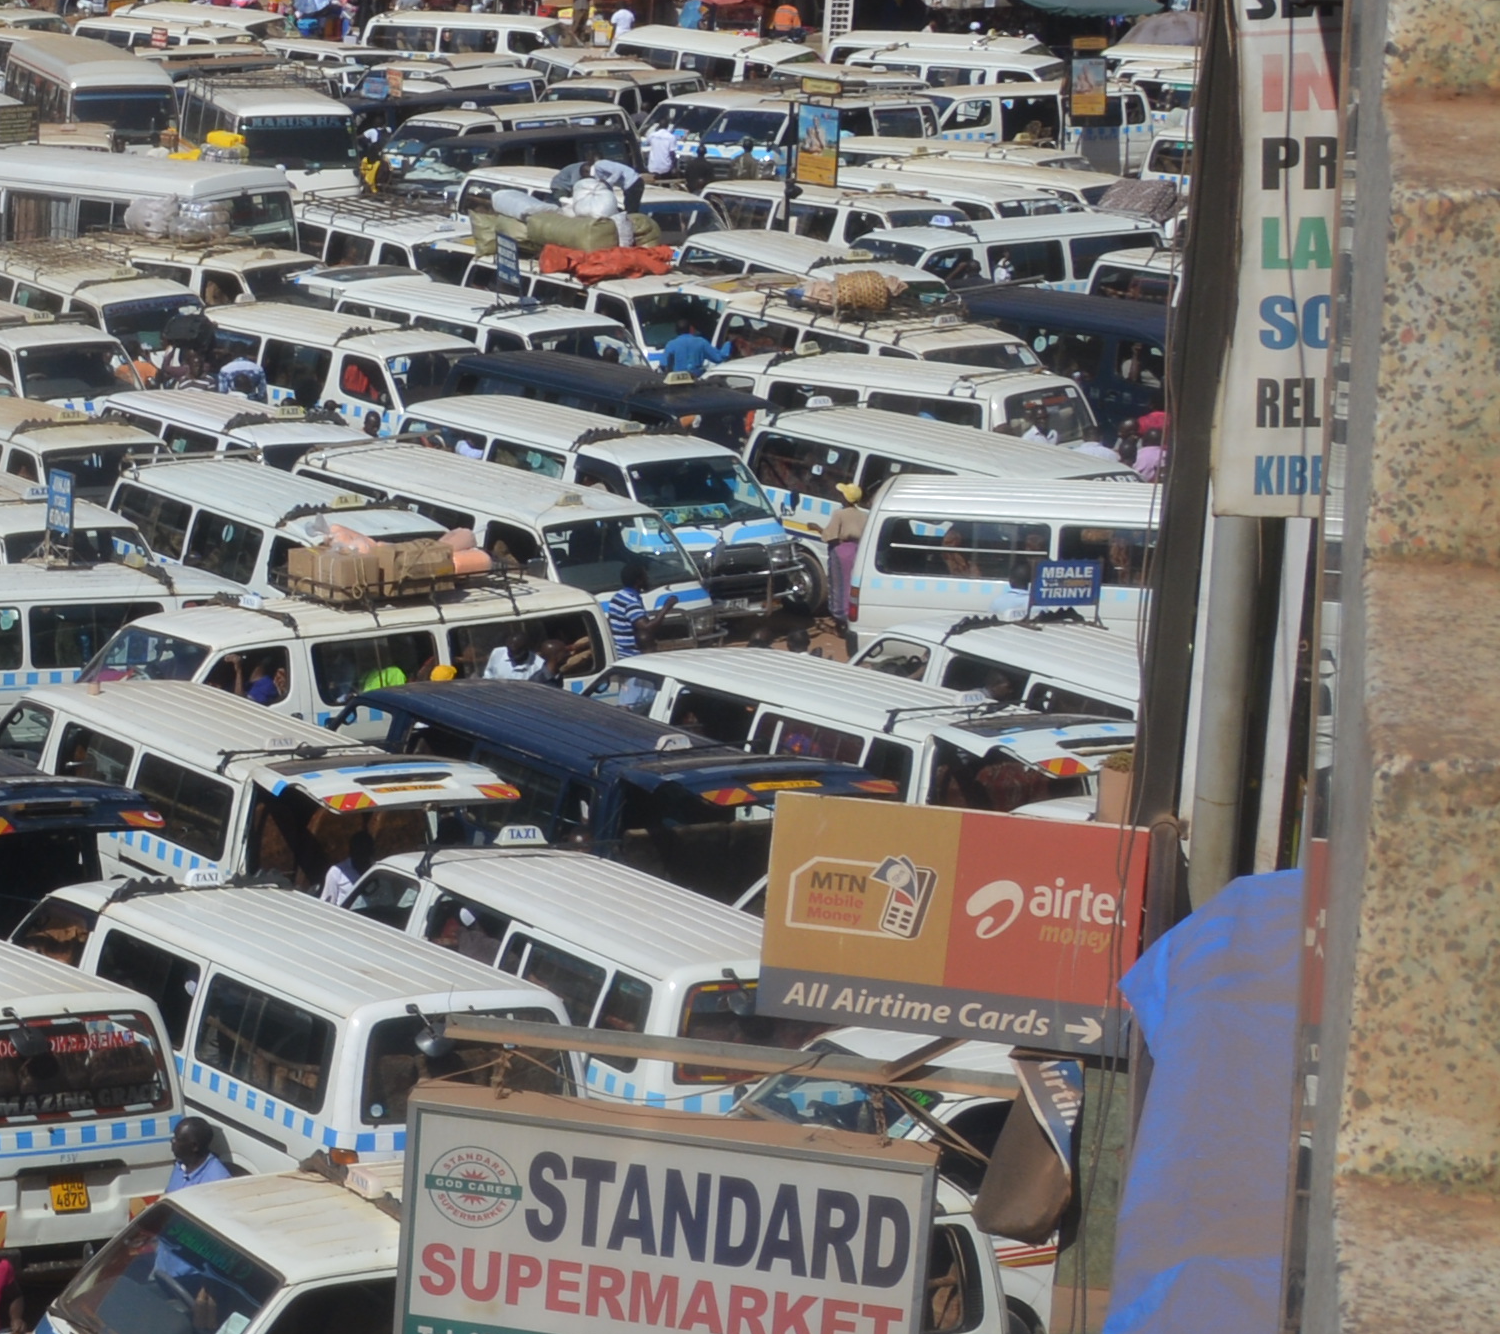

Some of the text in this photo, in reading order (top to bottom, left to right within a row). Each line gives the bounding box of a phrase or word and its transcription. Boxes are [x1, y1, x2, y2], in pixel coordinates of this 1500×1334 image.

[1262, 136, 1337, 190] PR
[1261, 216, 1334, 270] LA
[1040, 565, 1095, 580] MBALE
[1040, 585, 1094, 601] TIRINYI
[810, 869, 867, 894] MTN
[808, 890, 864, 911] Mobile
[806, 905, 862, 926] Money
[1039, 923, 1112, 955] money
[782, 981, 1050, 1038] All Airtime Cards
[434, 1177, 514, 1196] GOD CARES
[524, 1150, 912, 1290] STANDARD
